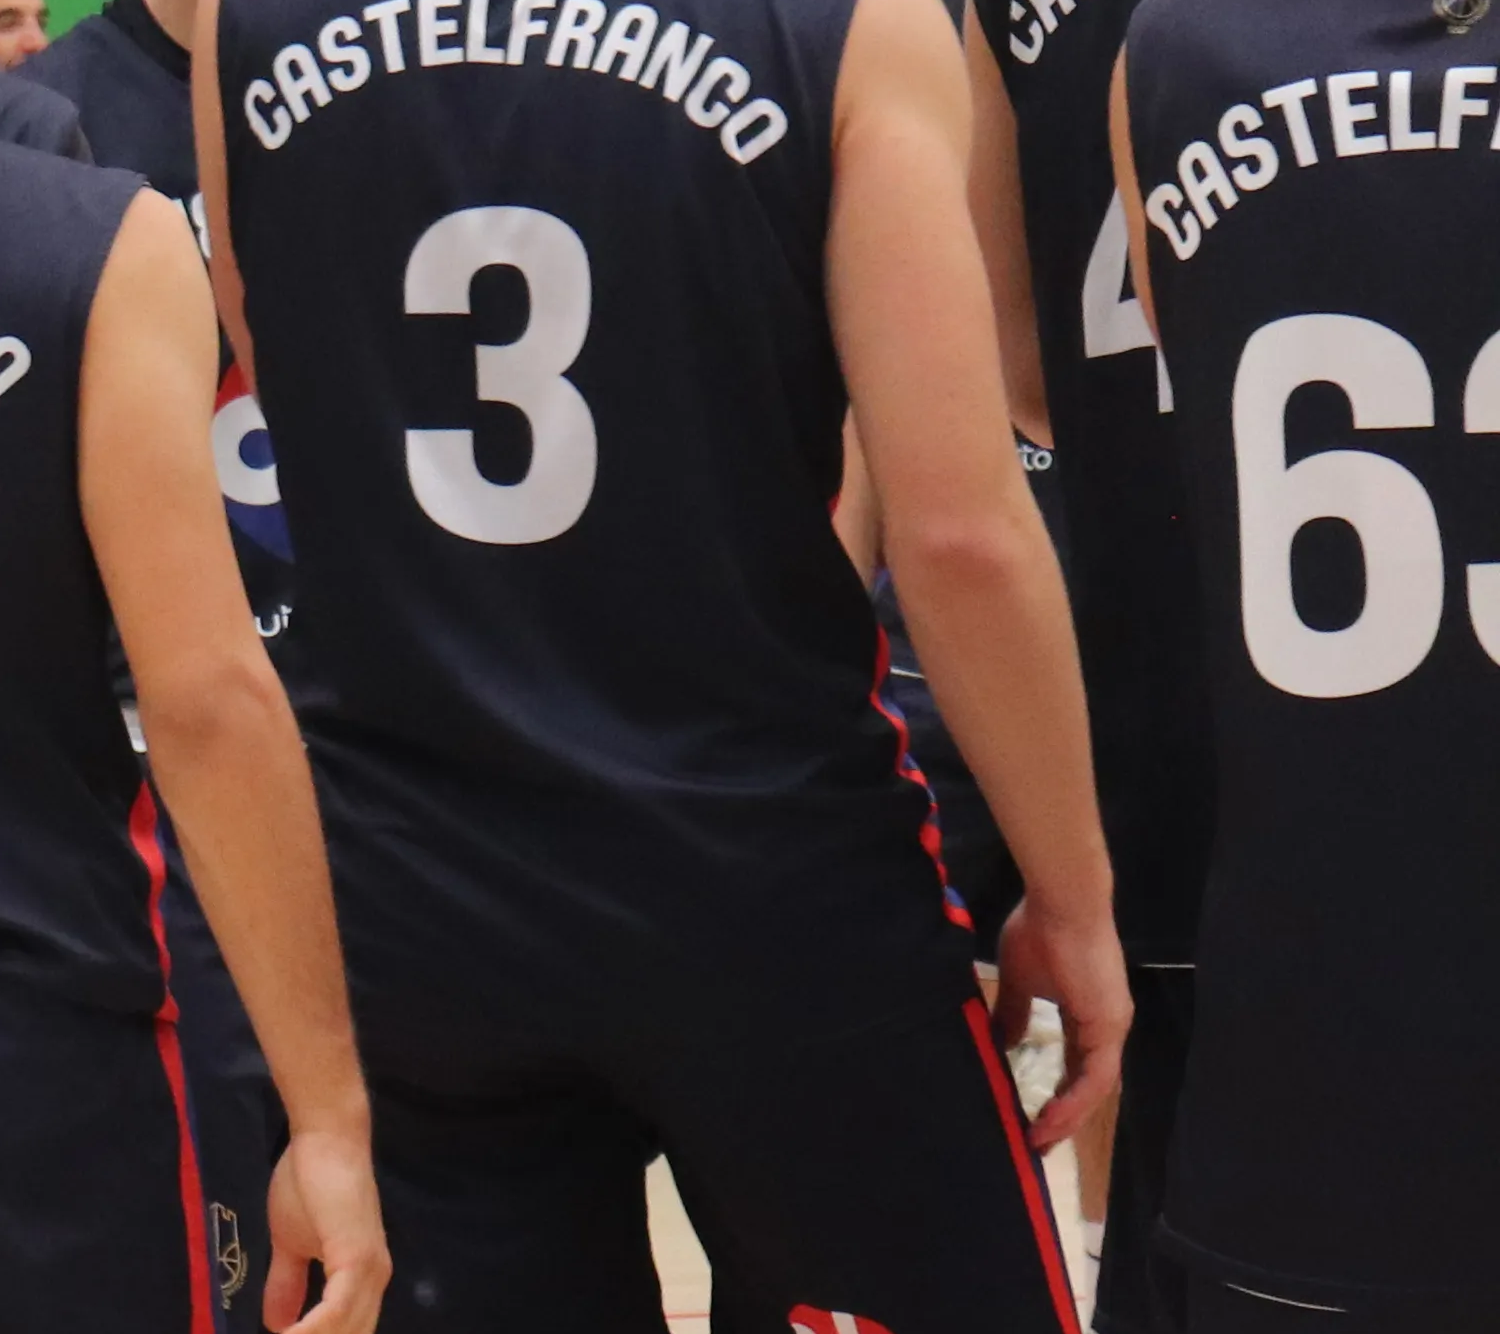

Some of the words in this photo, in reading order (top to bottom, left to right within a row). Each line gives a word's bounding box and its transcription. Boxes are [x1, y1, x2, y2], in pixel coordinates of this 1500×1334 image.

[1146, 66, 1500, 261] CASTELF
[404, 206, 597, 544] 3
[1232, 313, 1500, 698] 6
